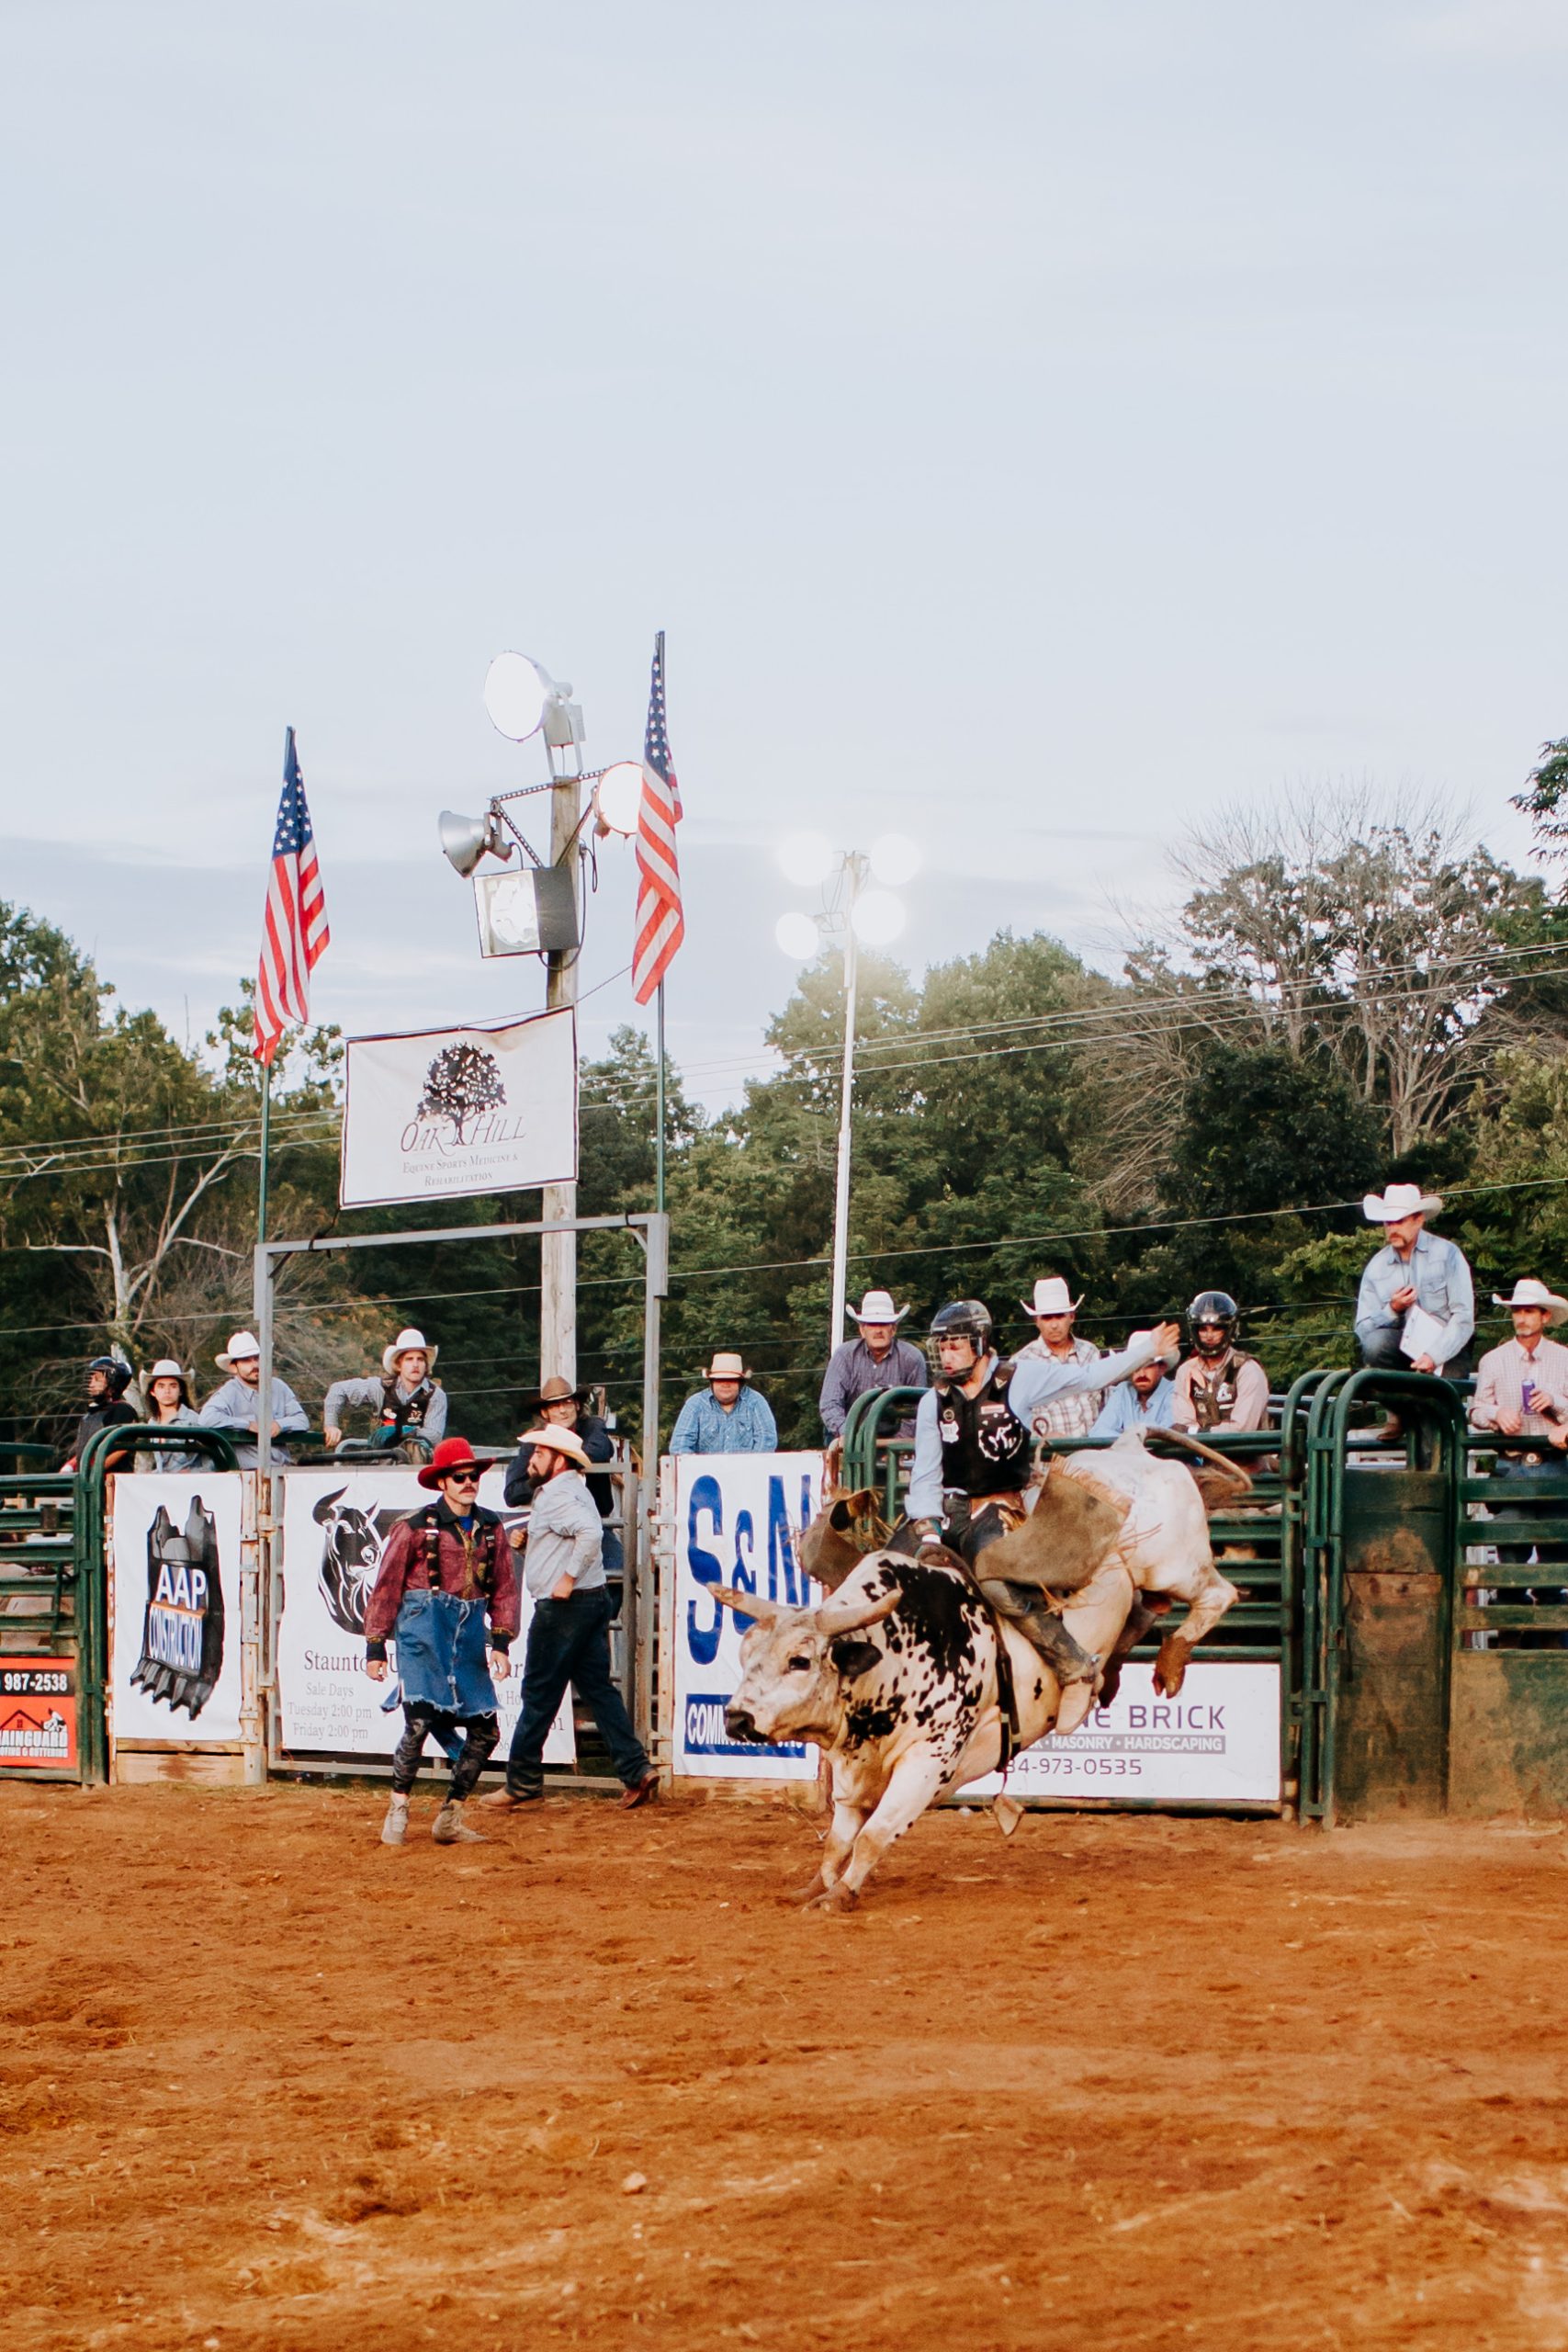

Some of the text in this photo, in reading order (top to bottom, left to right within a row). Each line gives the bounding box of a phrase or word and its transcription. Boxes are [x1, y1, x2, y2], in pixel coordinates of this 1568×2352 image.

[470, 1113, 526, 1145] HILL
[436, 1159, 467, 1170] SPORTS
[469, 1154, 511, 1167] MEDICINE
[687, 1475, 810, 1666] S&N
[155, 1564, 207, 1611] AAP
[149, 1606, 203, 1670] CONSTRUCTION
[304, 1650, 367, 1672] Staunto
[4, 1673, 68, 1691] 987-2538
[306, 1682, 355, 1701] Sale Days
[288, 1702, 372, 1723] Tuesday 2:00 pm
[1129, 1705, 1225, 1729] BRICK
[0, 1730, 68, 1747] AINGUARD
[293, 1723, 368, 1742] Friday 2:00 pm
[1052, 1736, 1113, 1750] MASONRY
[1124, 1736, 1223, 1751] HARDSCAPING
[1006, 1758, 1143, 1775] 34-973-0535
